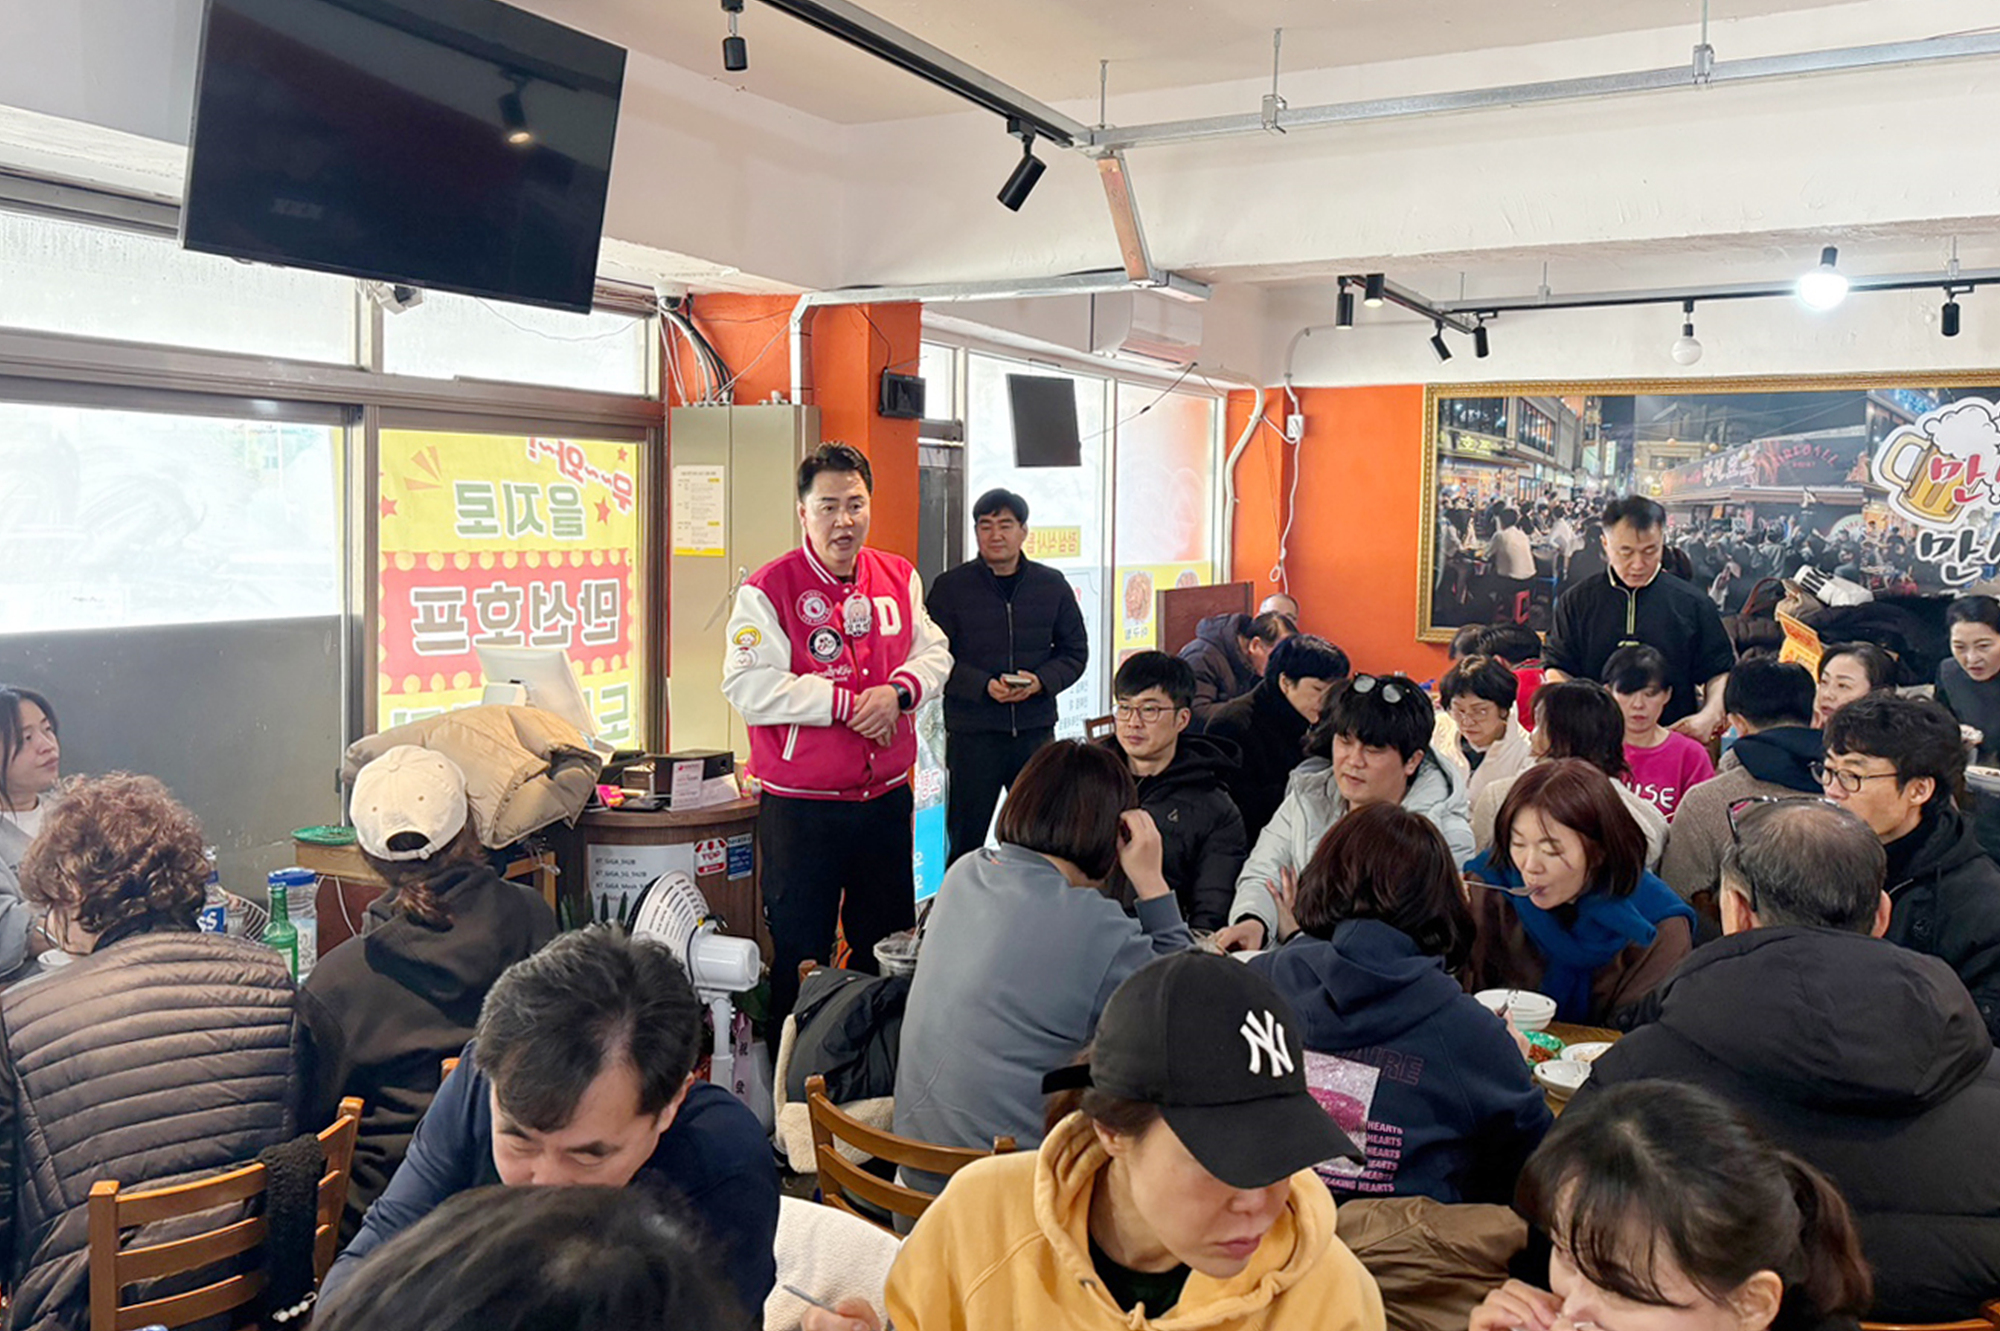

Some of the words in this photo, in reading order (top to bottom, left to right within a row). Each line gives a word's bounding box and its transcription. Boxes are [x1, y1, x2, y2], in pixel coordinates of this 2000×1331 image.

[1929, 453, 2000, 504] 만
[1920, 528, 2000, 582] 만
[872, 596, 902, 636] D
[1239, 1009, 1295, 1077] NY
[1366, 1134, 1402, 1147] HEARTS
[1366, 1146, 1402, 1160] HEARTS
[1357, 1180, 1396, 1193] HEARTS
